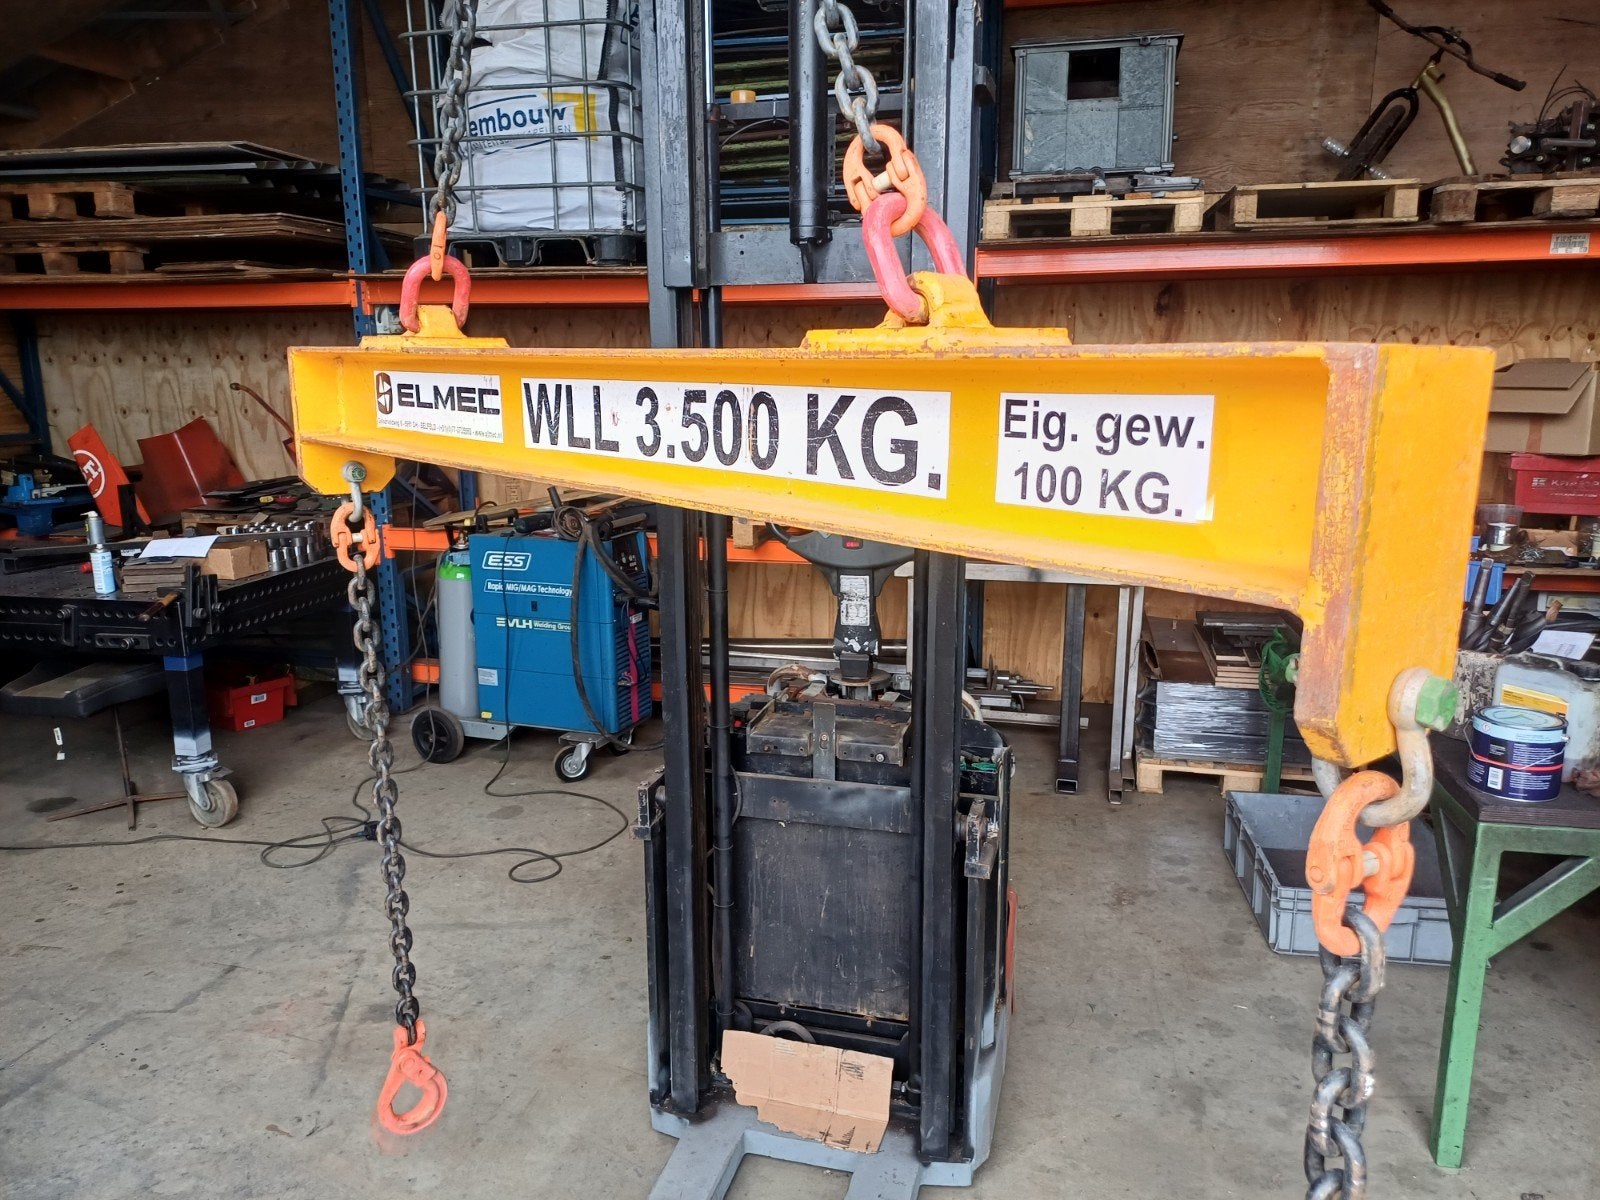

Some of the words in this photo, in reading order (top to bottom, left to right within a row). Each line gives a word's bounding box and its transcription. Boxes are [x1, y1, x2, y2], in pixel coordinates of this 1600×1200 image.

[468, 106, 567, 137] embouw
[396, 383, 501, 416] ELMEC
[522, 382, 620, 453] WLL
[634, 385, 780, 471] 3.500
[805, 392, 942, 491] KG.
[1003, 398, 1078, 452] Eig.
[1095, 412, 1205, 456] gew.
[1013, 461, 1083, 506] 100
[1098, 468, 1183, 517] KG.
[487, 554, 526, 568] ESS
[505, 583, 537, 594] MIG/MAG
[537, 585, 573, 597] Technology
